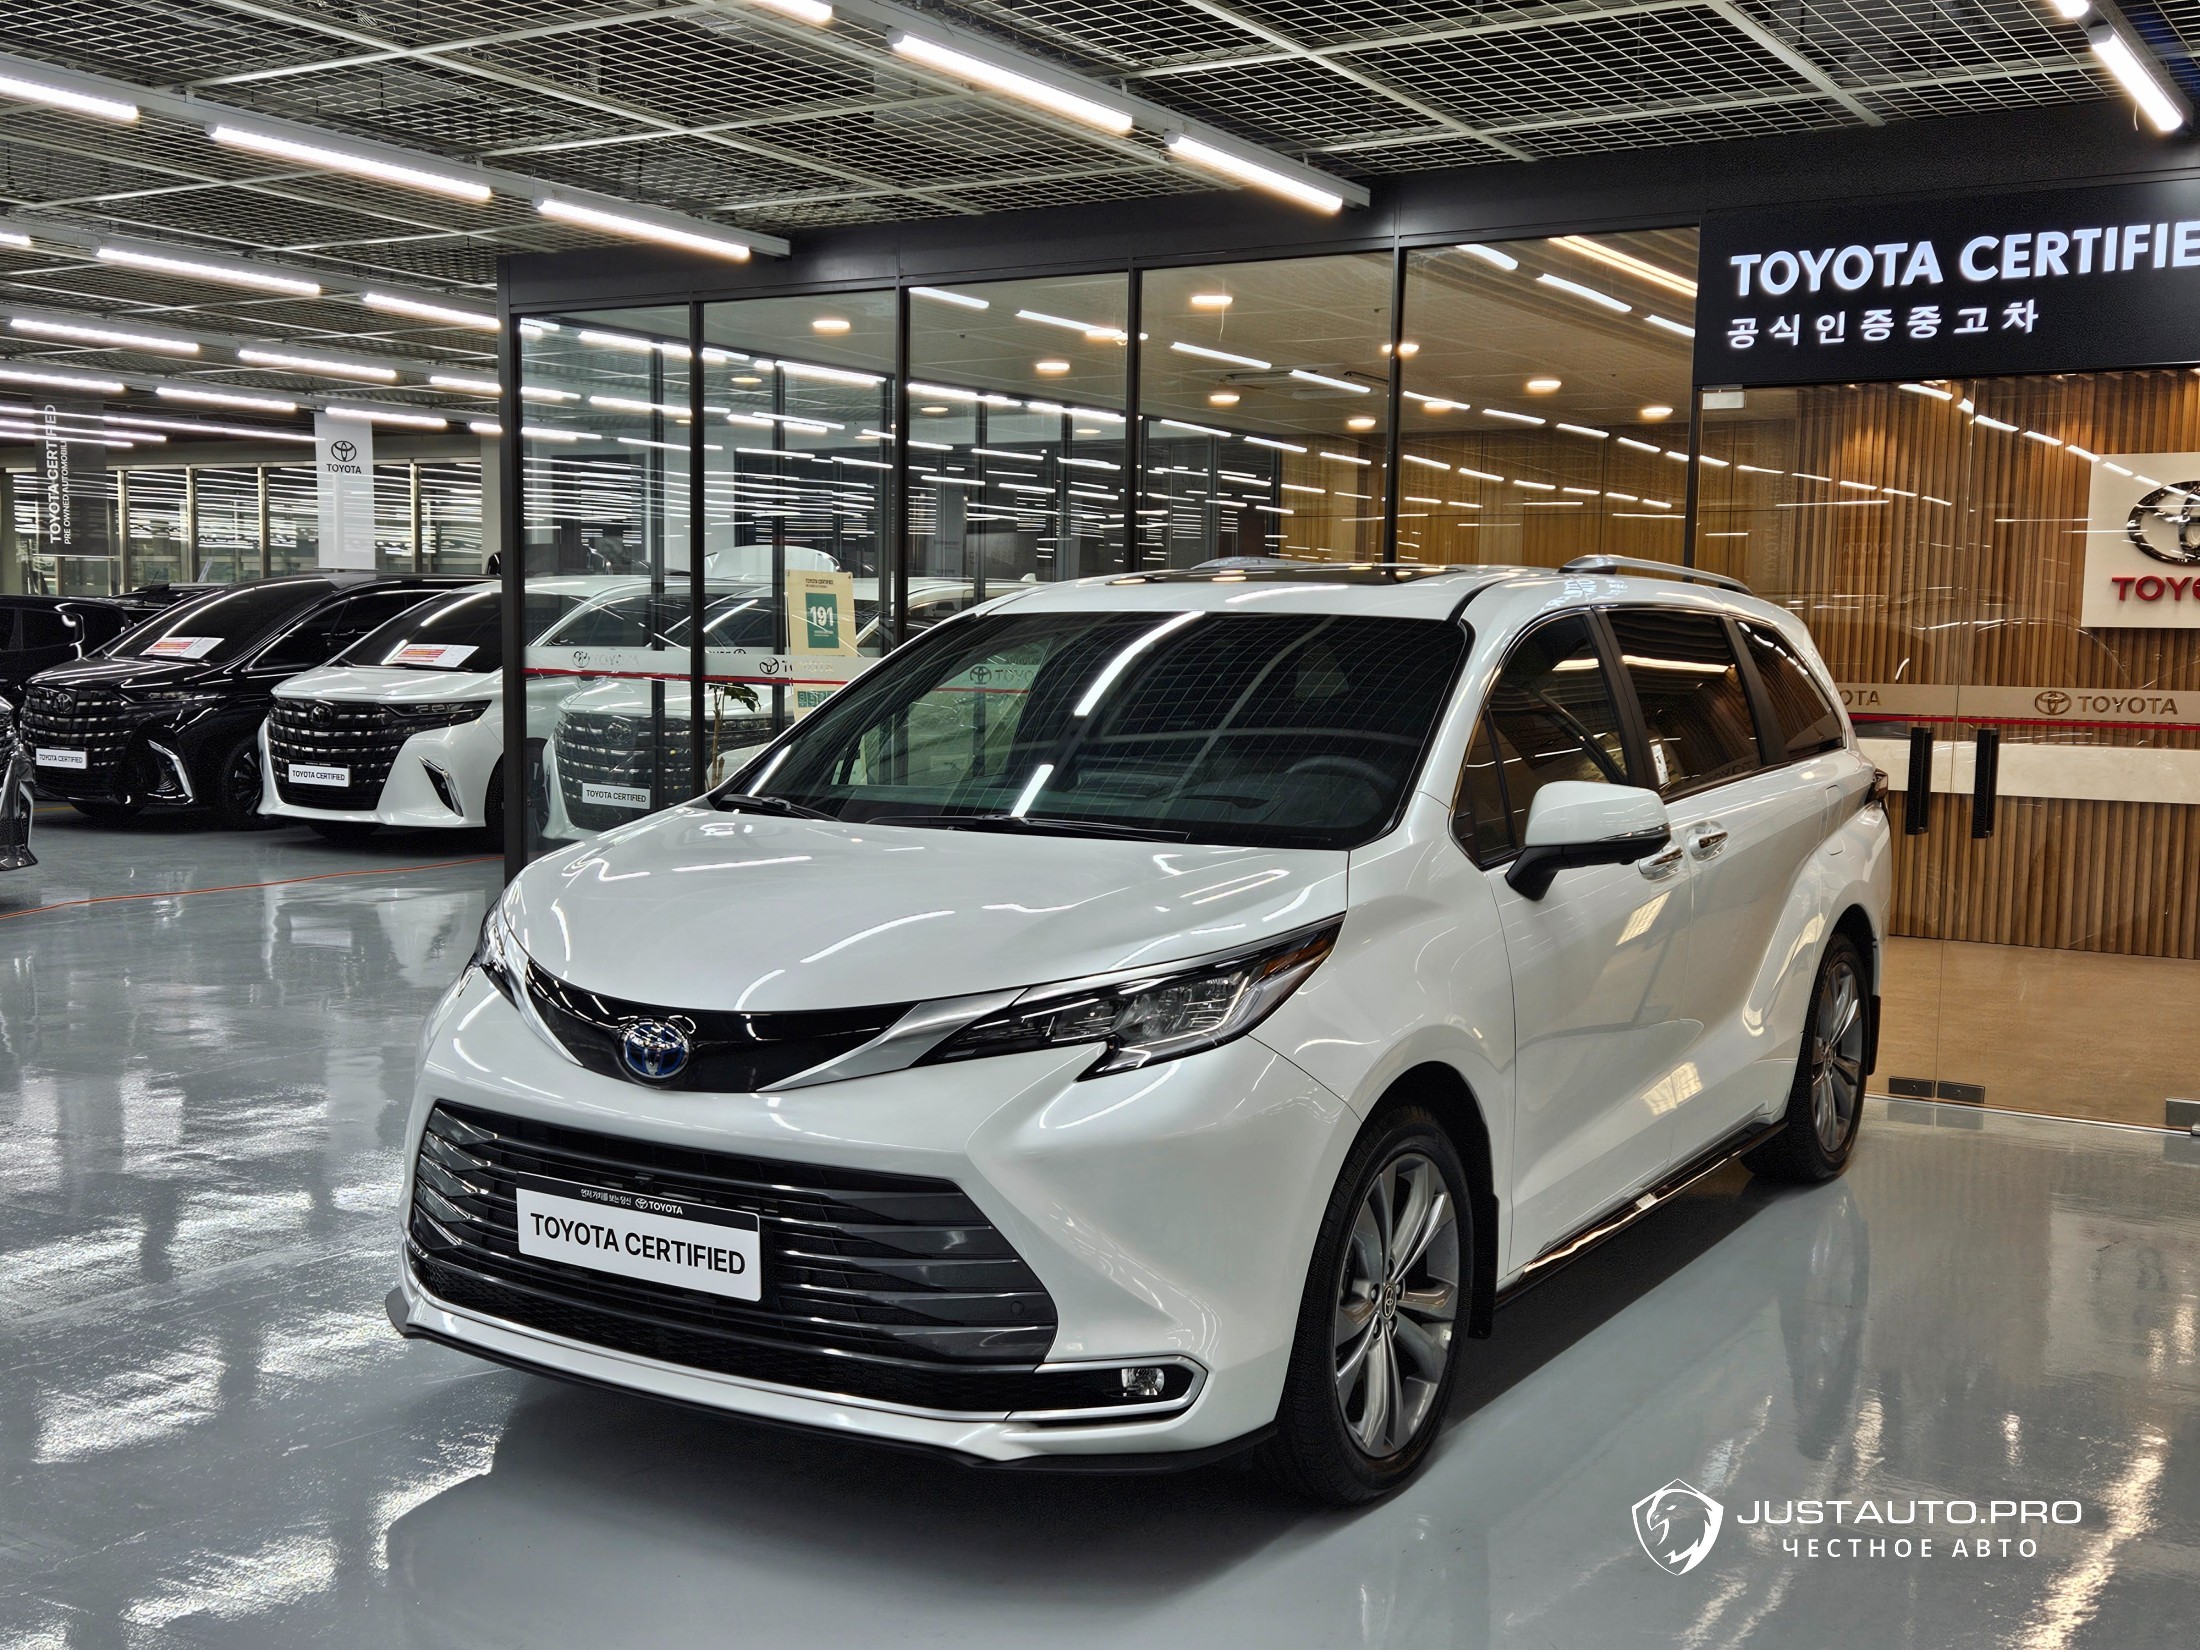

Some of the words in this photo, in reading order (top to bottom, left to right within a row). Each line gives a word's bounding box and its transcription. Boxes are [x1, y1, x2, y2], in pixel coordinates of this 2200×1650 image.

[1729, 240, 1945, 297] TOYOTA
[1958, 219, 2200, 283] CERTIFIE
[1726, 299, 2039, 349] 공식인증중고차
[44, 404, 59, 480] CERTFIED
[326, 463, 362, 474] TOYOTA
[47, 482, 62, 544] TOYOTA
[61, 493, 71, 527] OWNED
[63, 528, 72, 545] PRE
[2111, 575, 2200, 602] TOY
[808, 606, 834, 627] 191
[2077, 695, 2179, 715] TOYOTA
[292, 769, 315, 778] TOYOTA
[316, 772, 346, 781] CERTIFIED
[586, 789, 612, 799] TOYOTA
[613, 792, 647, 803] CERTIFIED
[648, 1200, 684, 1215] TOYOTA
[529, 1212, 620, 1252] TOYOTA
[624, 1231, 746, 1275] CERTIFIED
